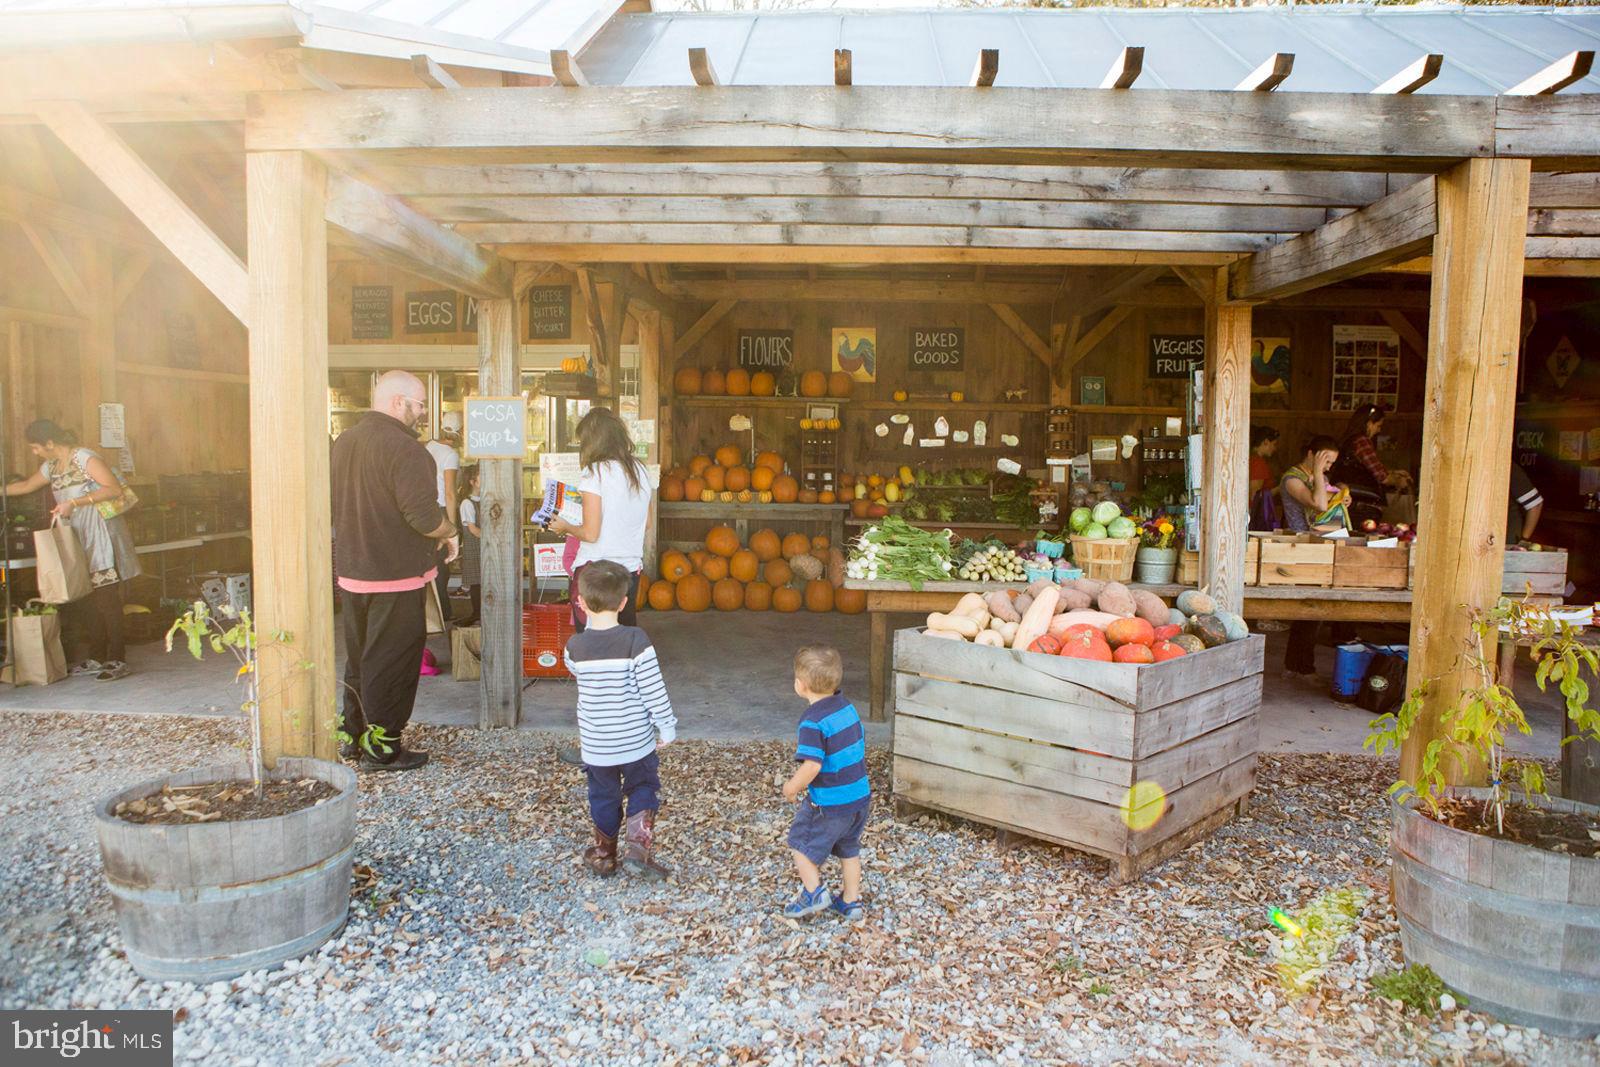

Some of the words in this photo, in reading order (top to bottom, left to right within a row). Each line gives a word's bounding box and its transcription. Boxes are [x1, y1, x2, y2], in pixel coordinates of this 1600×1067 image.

[533, 289, 563, 305] CHEESE
[408, 301, 453, 325] EGGS
[534, 306, 567, 320] BUTTER
[534, 322, 564, 336] YOGURT
[915, 332, 958, 348] BAKED
[1153, 338, 1203, 355] VEGGIES
[740, 335, 792, 367] FLOWERS
[913, 350, 959, 365] GOODS
[484, 404, 517, 422] CSA
[469, 430, 501, 448] SHOP
